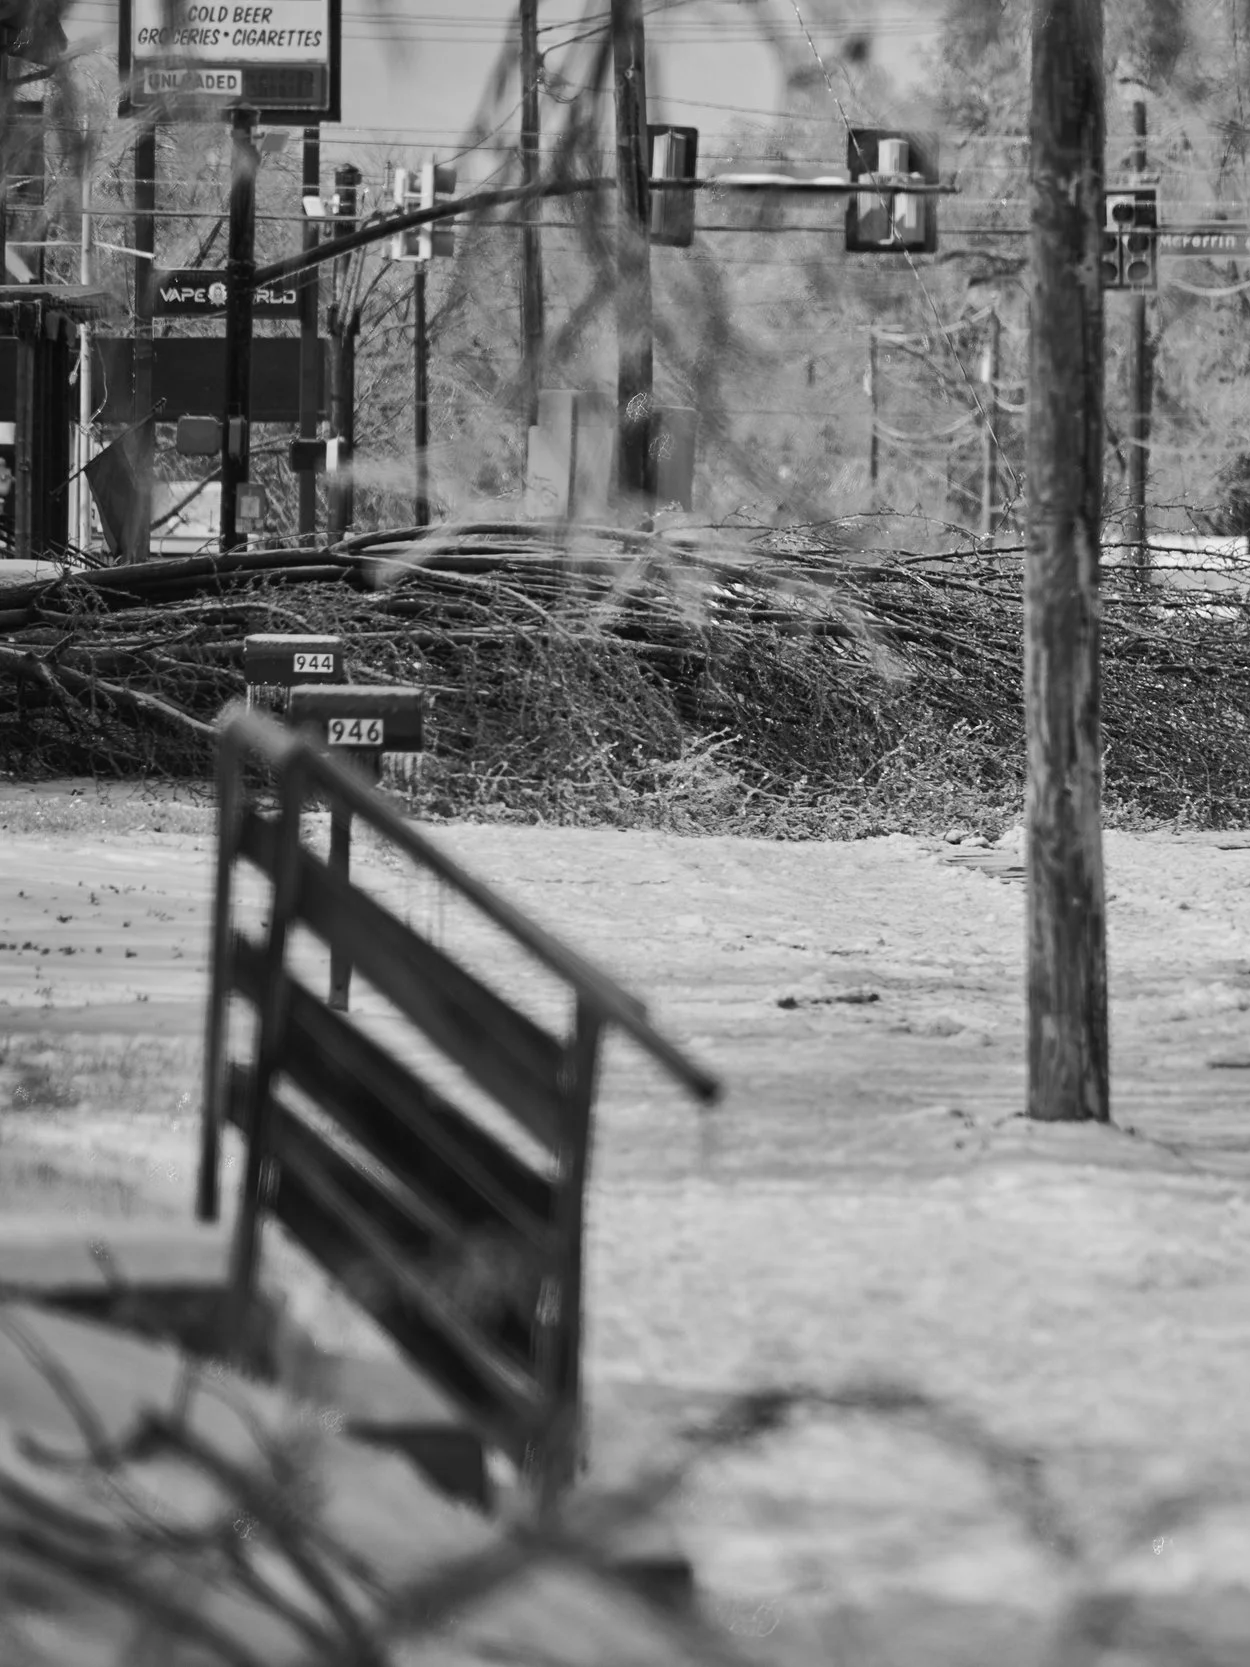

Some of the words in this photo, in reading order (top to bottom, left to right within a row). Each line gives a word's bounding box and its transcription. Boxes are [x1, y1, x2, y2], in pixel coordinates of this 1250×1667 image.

[188, 5, 228, 23] COLD
[232, 7, 273, 24] BEER
[232, 29, 322, 47] CIGARETTES
[148, 73, 238, 91] UNLADED
[160, 287, 207, 303] VAPE
[296, 655, 332, 670] 944
[331, 720, 380, 742] 946
